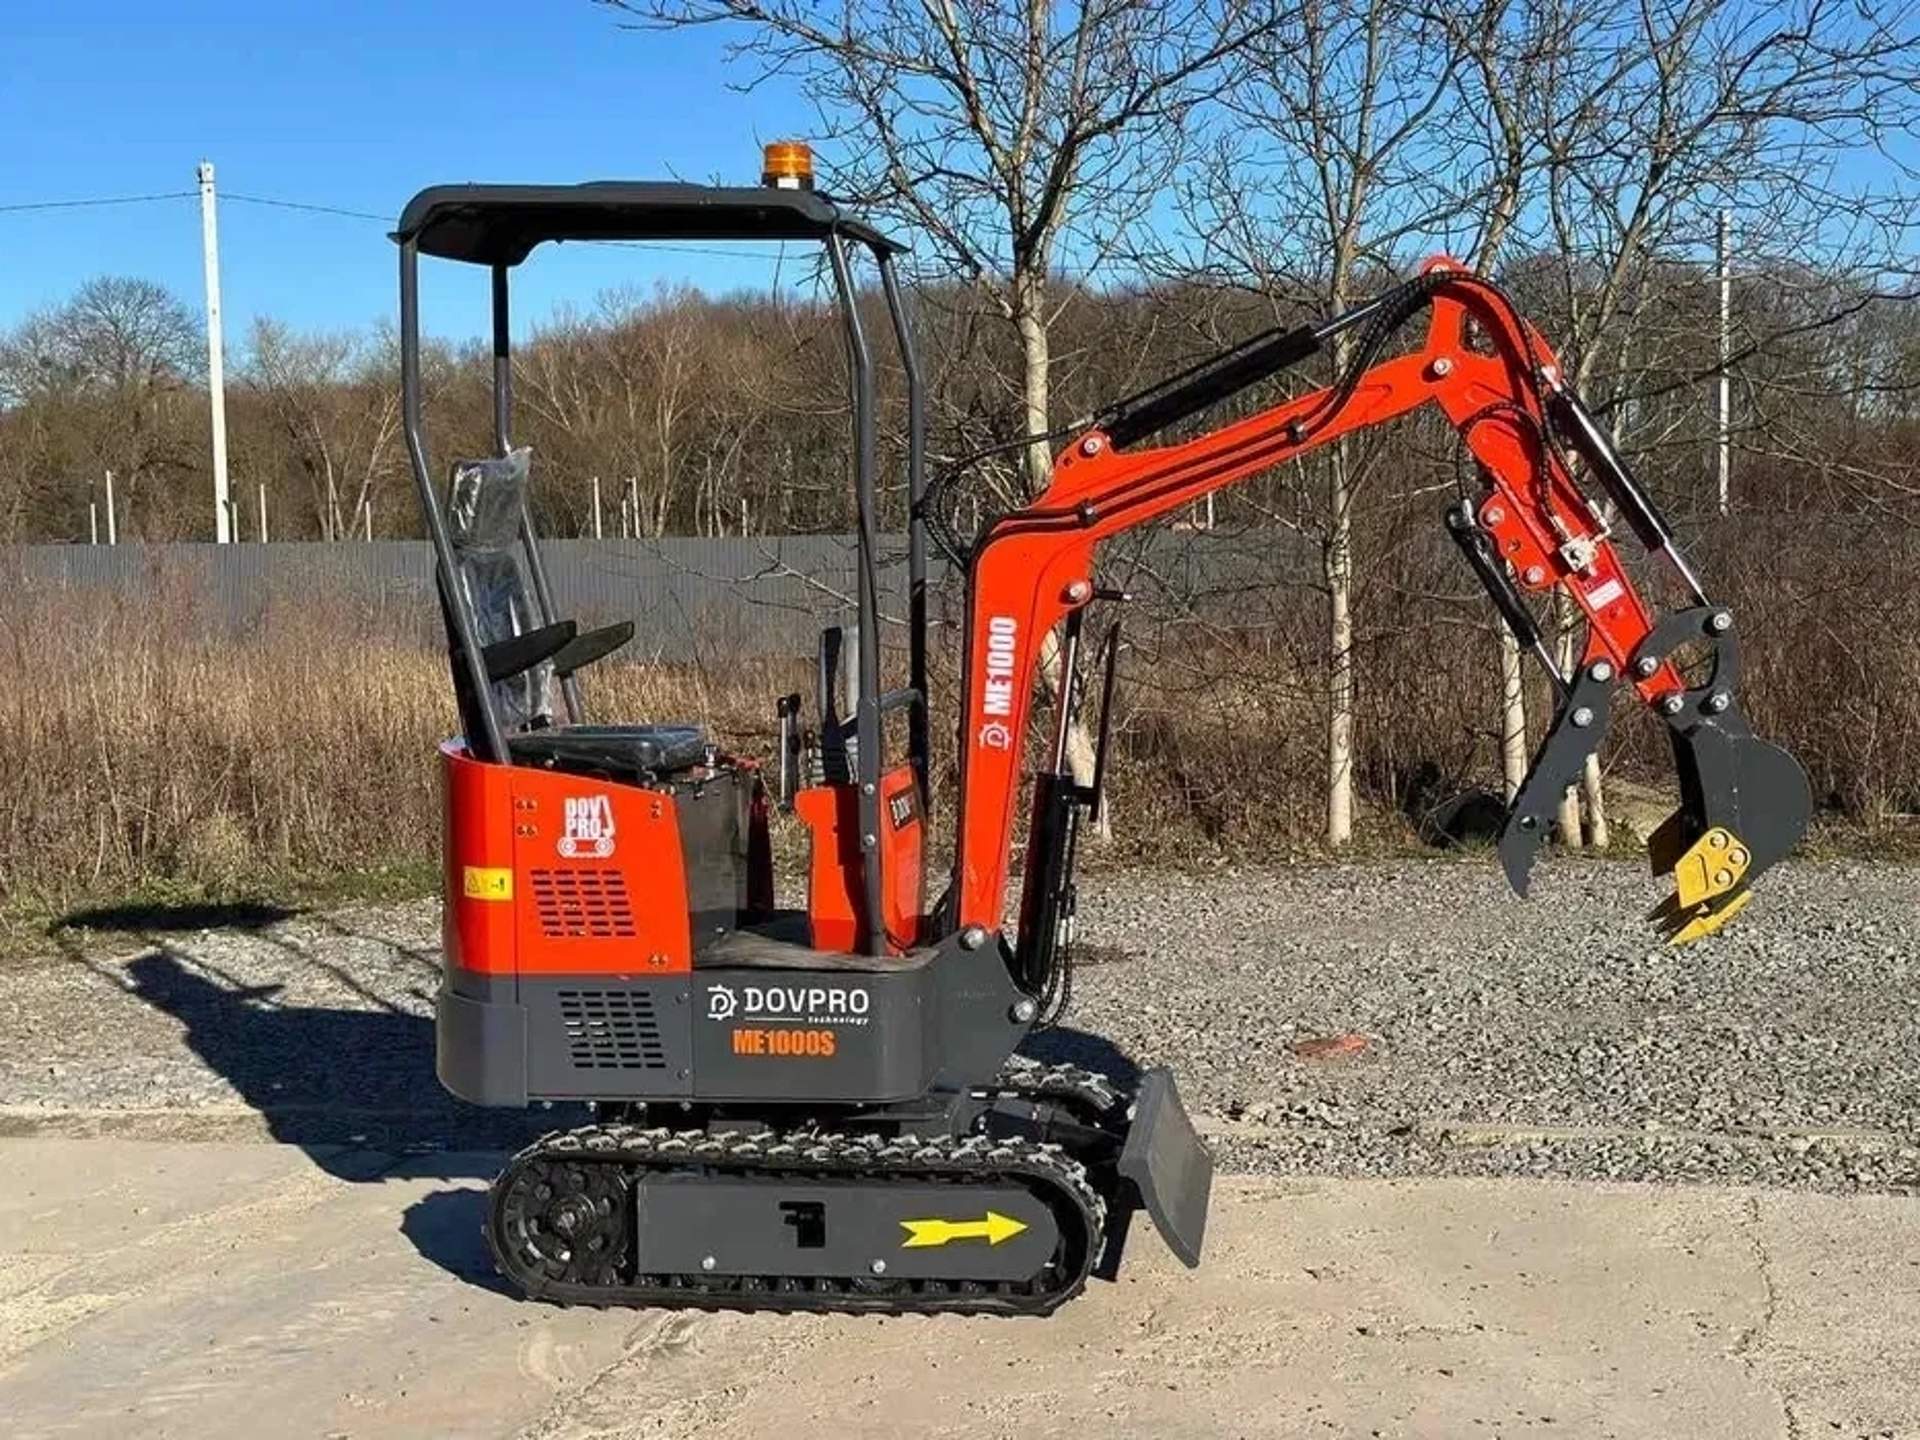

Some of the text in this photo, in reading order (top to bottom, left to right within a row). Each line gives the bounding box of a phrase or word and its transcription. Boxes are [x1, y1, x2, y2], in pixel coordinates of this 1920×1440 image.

[983, 616, 1017, 715] ME1000
[565, 797, 601, 817] DOV
[566, 818, 601, 838] PRO
[743, 988, 869, 1013] DOVPRO
[808, 1016, 869, 1025] technology
[733, 1030, 835, 1056] ME1000S
